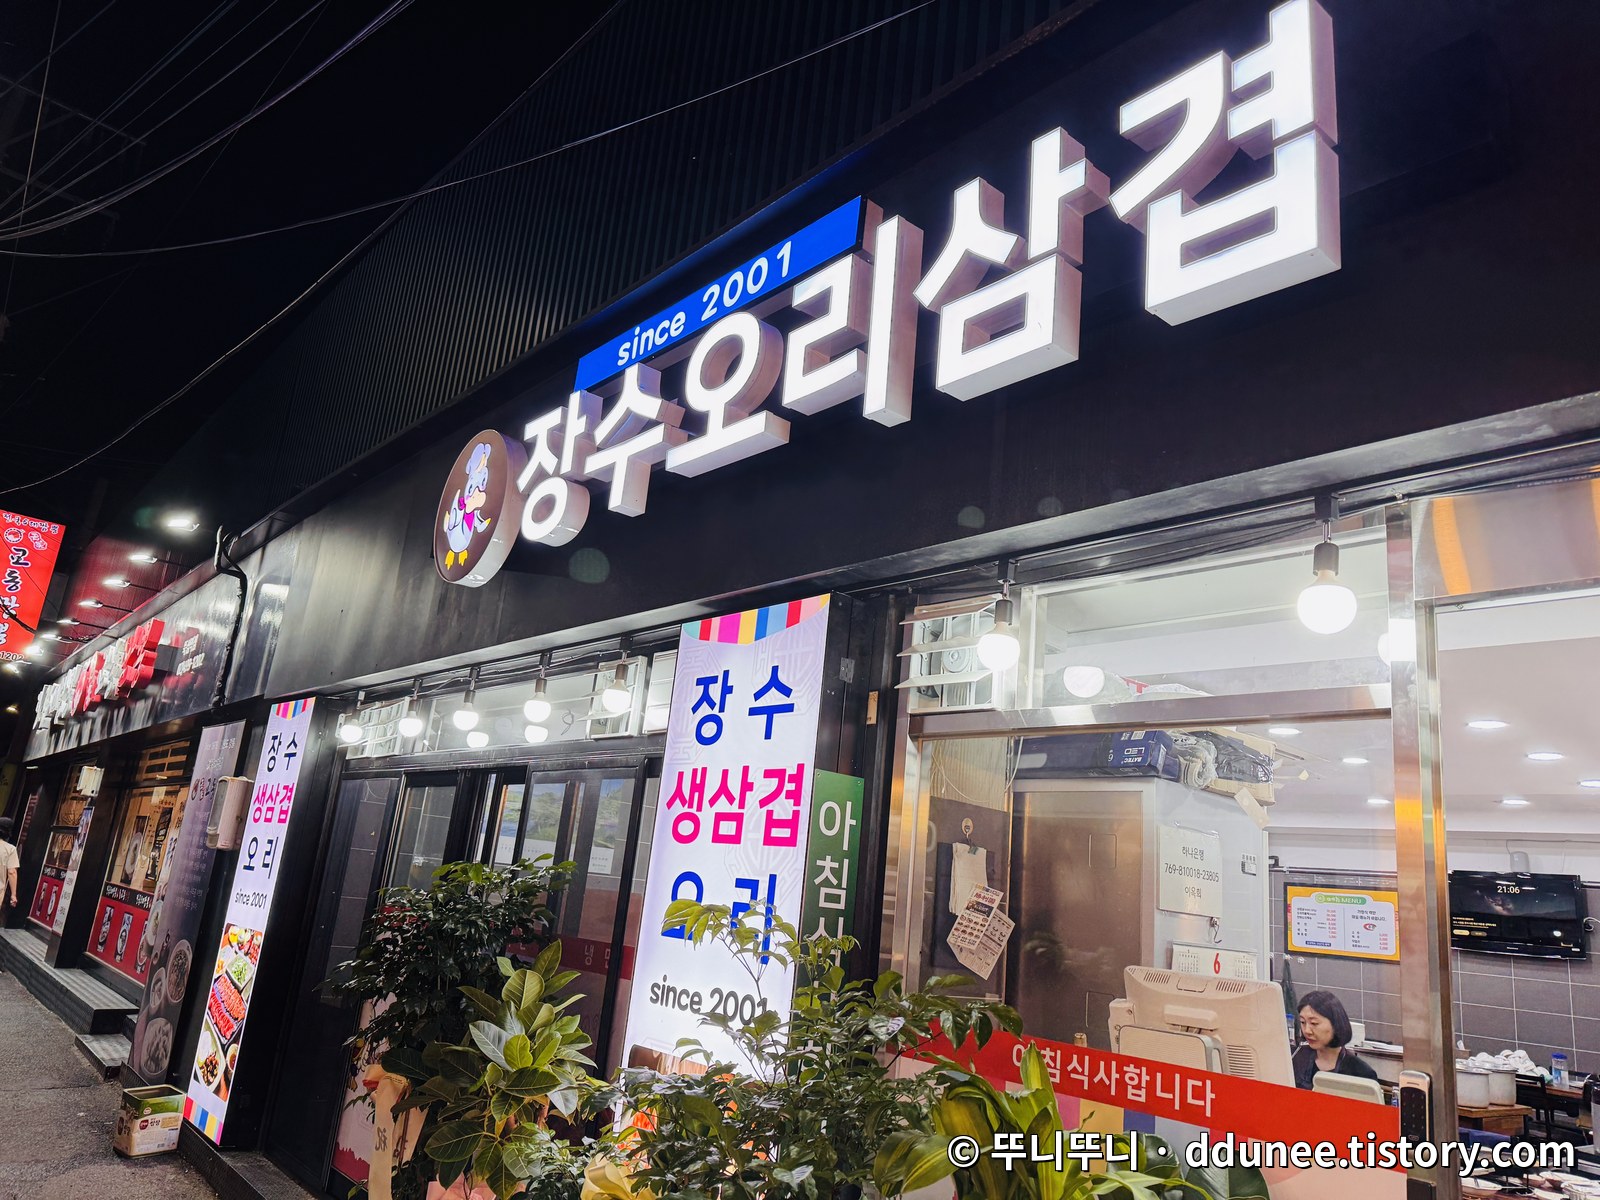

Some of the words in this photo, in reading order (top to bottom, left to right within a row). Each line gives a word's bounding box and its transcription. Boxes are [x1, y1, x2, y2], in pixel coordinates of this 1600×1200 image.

[516, 0, 1325, 542] 장수오리삼겹
[616, 309, 687, 367] since
[701, 240, 793, 322] 2001
[690, 664, 796, 747] 장수
[266, 731, 299, 773] 장수
[252, 782, 296, 824] 생삼겹
[665, 762, 806, 848] 생삼겹
[242, 835, 280, 880] 오리
[1181, 846, 1205, 861] 하나은행
[234, 888, 250, 905] since
[250, 891, 269, 911] 2001
[1496, 885, 1521, 894] 21:06
[1213, 952, 1221, 975] 6
[649, 974, 702, 1017] since
